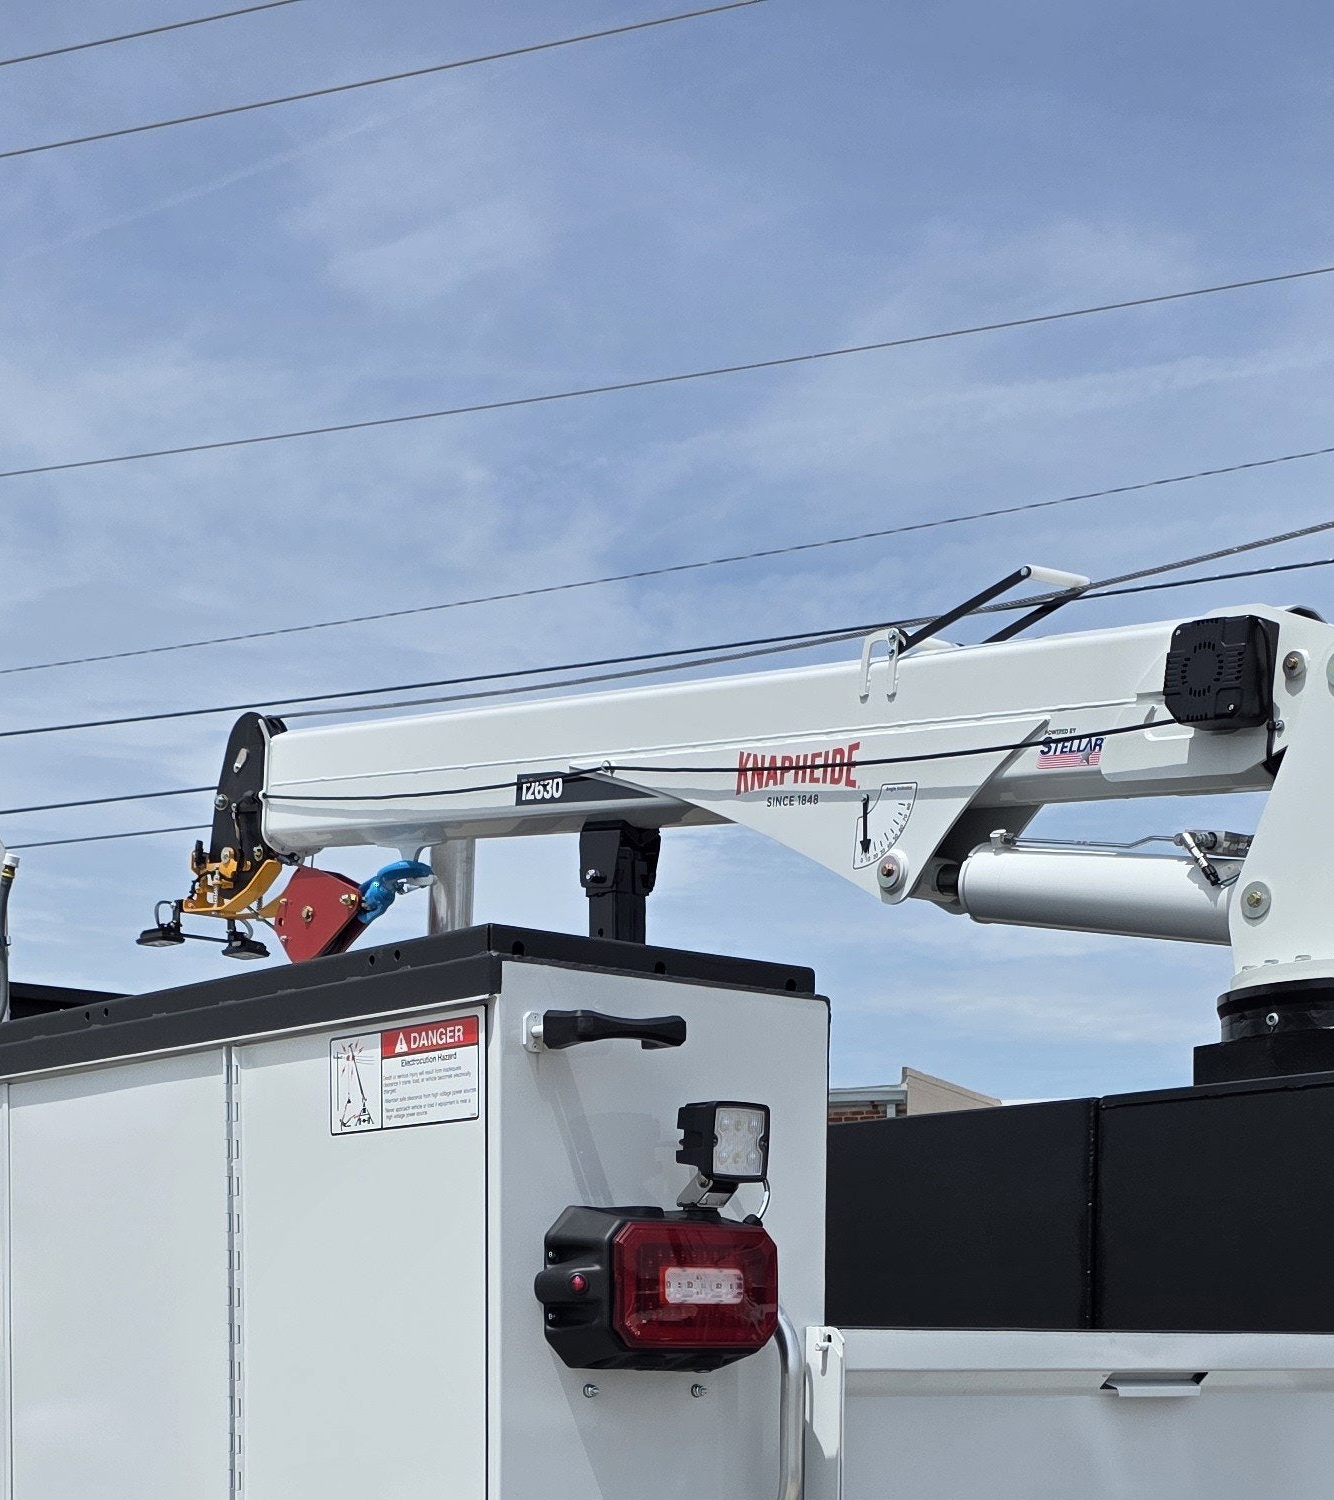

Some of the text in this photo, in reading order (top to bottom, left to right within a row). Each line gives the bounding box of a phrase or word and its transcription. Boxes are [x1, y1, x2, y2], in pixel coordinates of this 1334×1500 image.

[1039, 737, 1104, 756] STELLAR
[735, 741, 861, 796] KNAPHEIDE
[521, 778, 563, 801] 12630
[766, 794, 819, 808] SINCE 1848
[410, 1025, 464, 1049] DANGER
[400, 1052, 458, 1068] Electrocution Hazard
